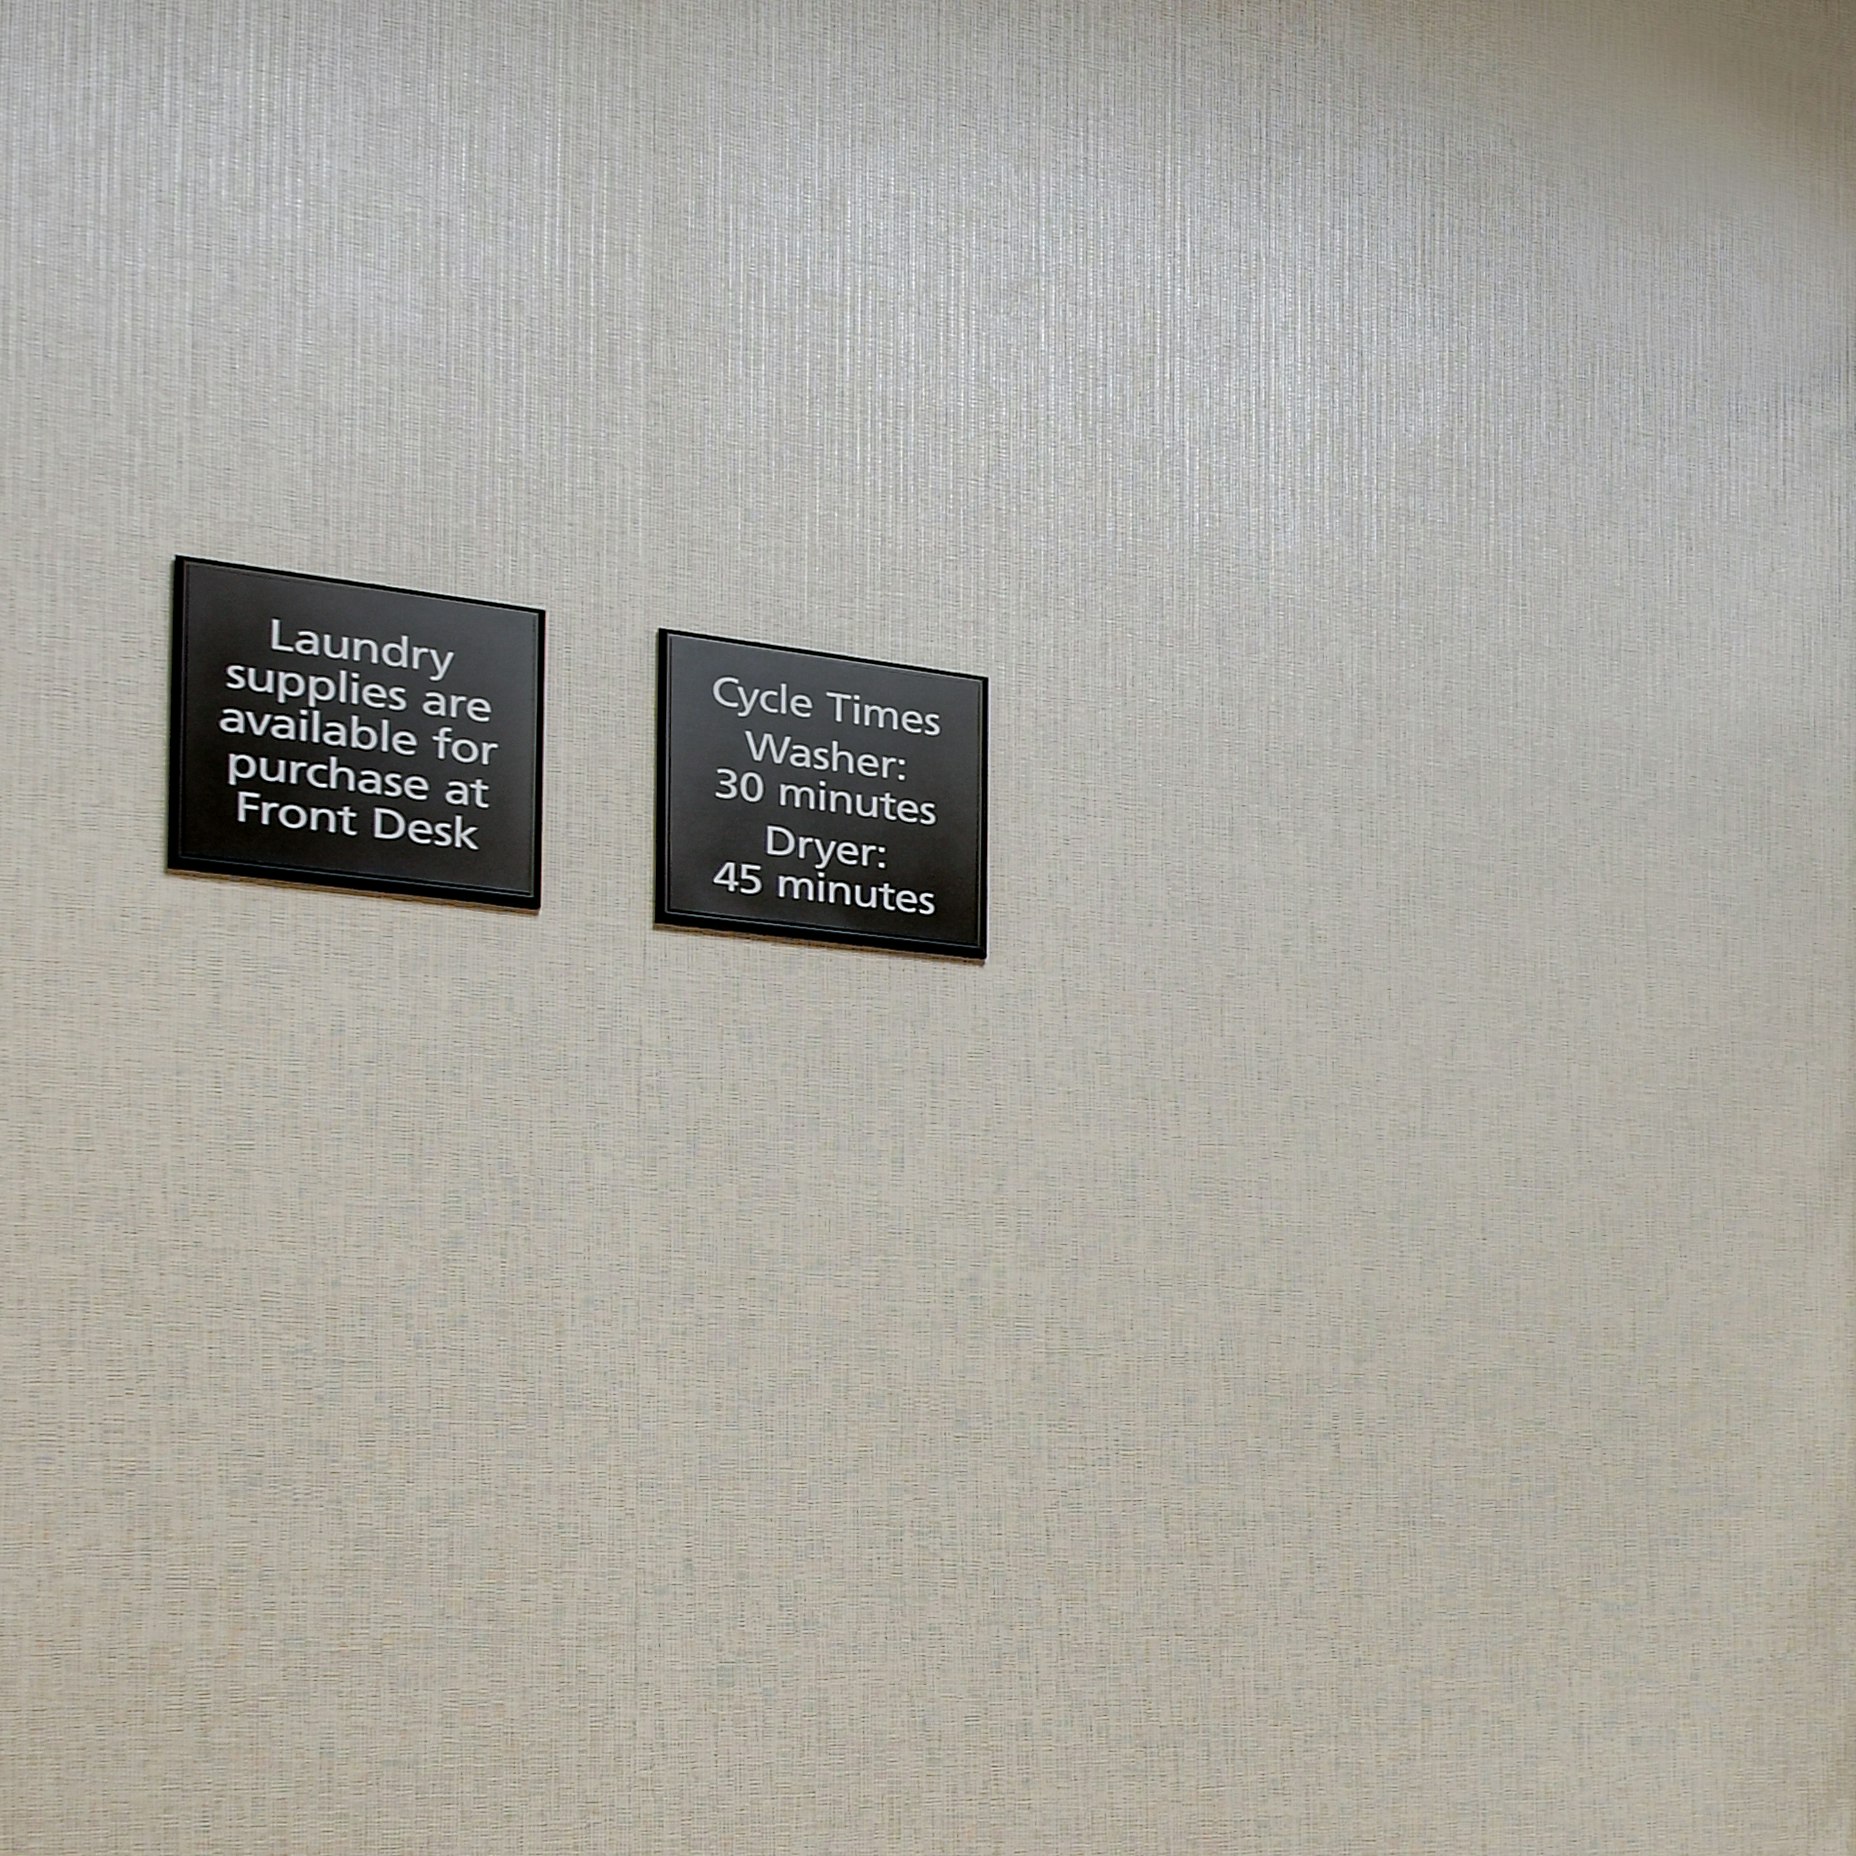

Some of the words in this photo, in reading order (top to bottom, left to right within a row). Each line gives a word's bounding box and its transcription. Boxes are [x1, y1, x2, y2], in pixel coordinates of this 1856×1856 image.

[271, 618, 454, 681] Laundry
[225, 664, 407, 711] supplies
[422, 690, 492, 722] are
[713, 676, 813, 718] Cycle
[826, 691, 941, 736] Times
[219, 707, 418, 756] available
[432, 728, 498, 765] for
[744, 730, 906, 781] Washer:
[228, 753, 429, 801] purchase
[445, 778, 490, 809] at
[714, 768, 764, 803] 30
[779, 780, 937, 825] minutes
[237, 791, 358, 836] Front
[373, 807, 480, 850] Desk
[766, 825, 886, 869] Dryer:
[713, 861, 763, 895] 45
[777, 872, 936, 915] minutes
